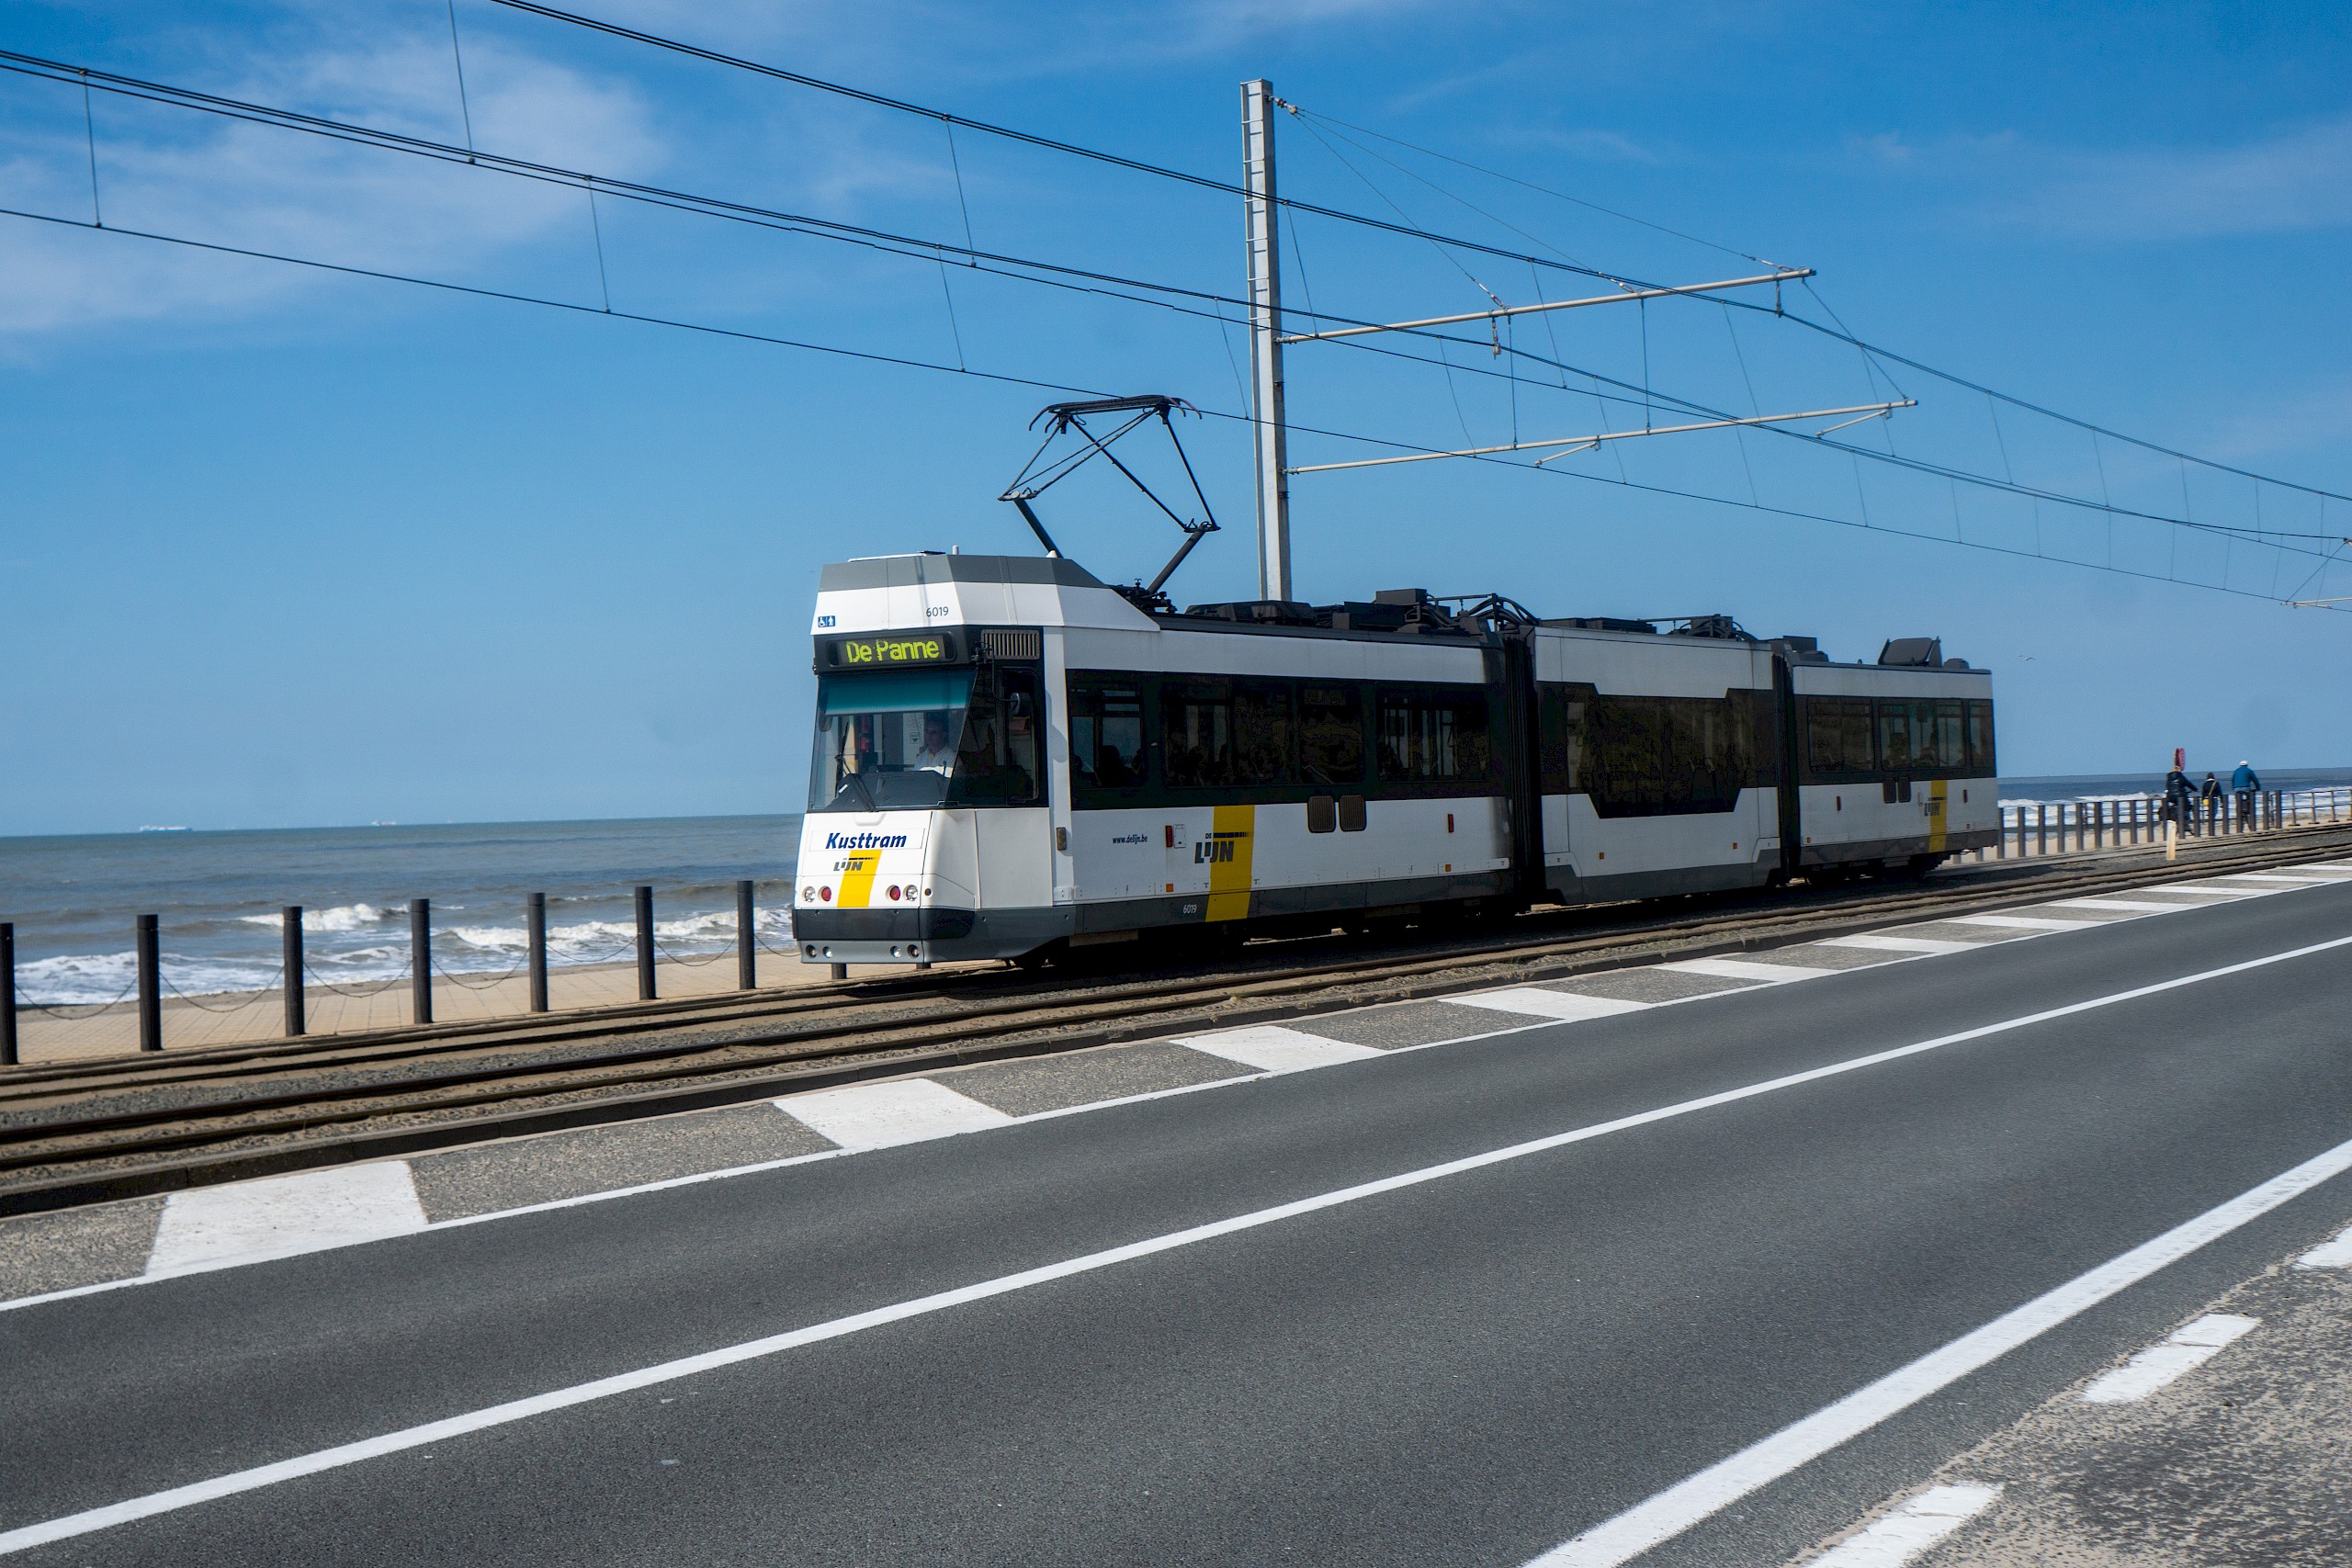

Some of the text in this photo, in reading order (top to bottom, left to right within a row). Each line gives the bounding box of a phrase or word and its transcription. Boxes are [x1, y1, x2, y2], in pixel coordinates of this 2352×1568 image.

[926, 606, 949, 617] 6019
[846, 639, 940, 663] De Panne
[825, 832, 907, 849] Kusttram
[1113, 834, 1148, 845] www.delijn.be
[1194, 840, 1235, 863] LIJN
[1182, 904, 1197, 914] 6019
